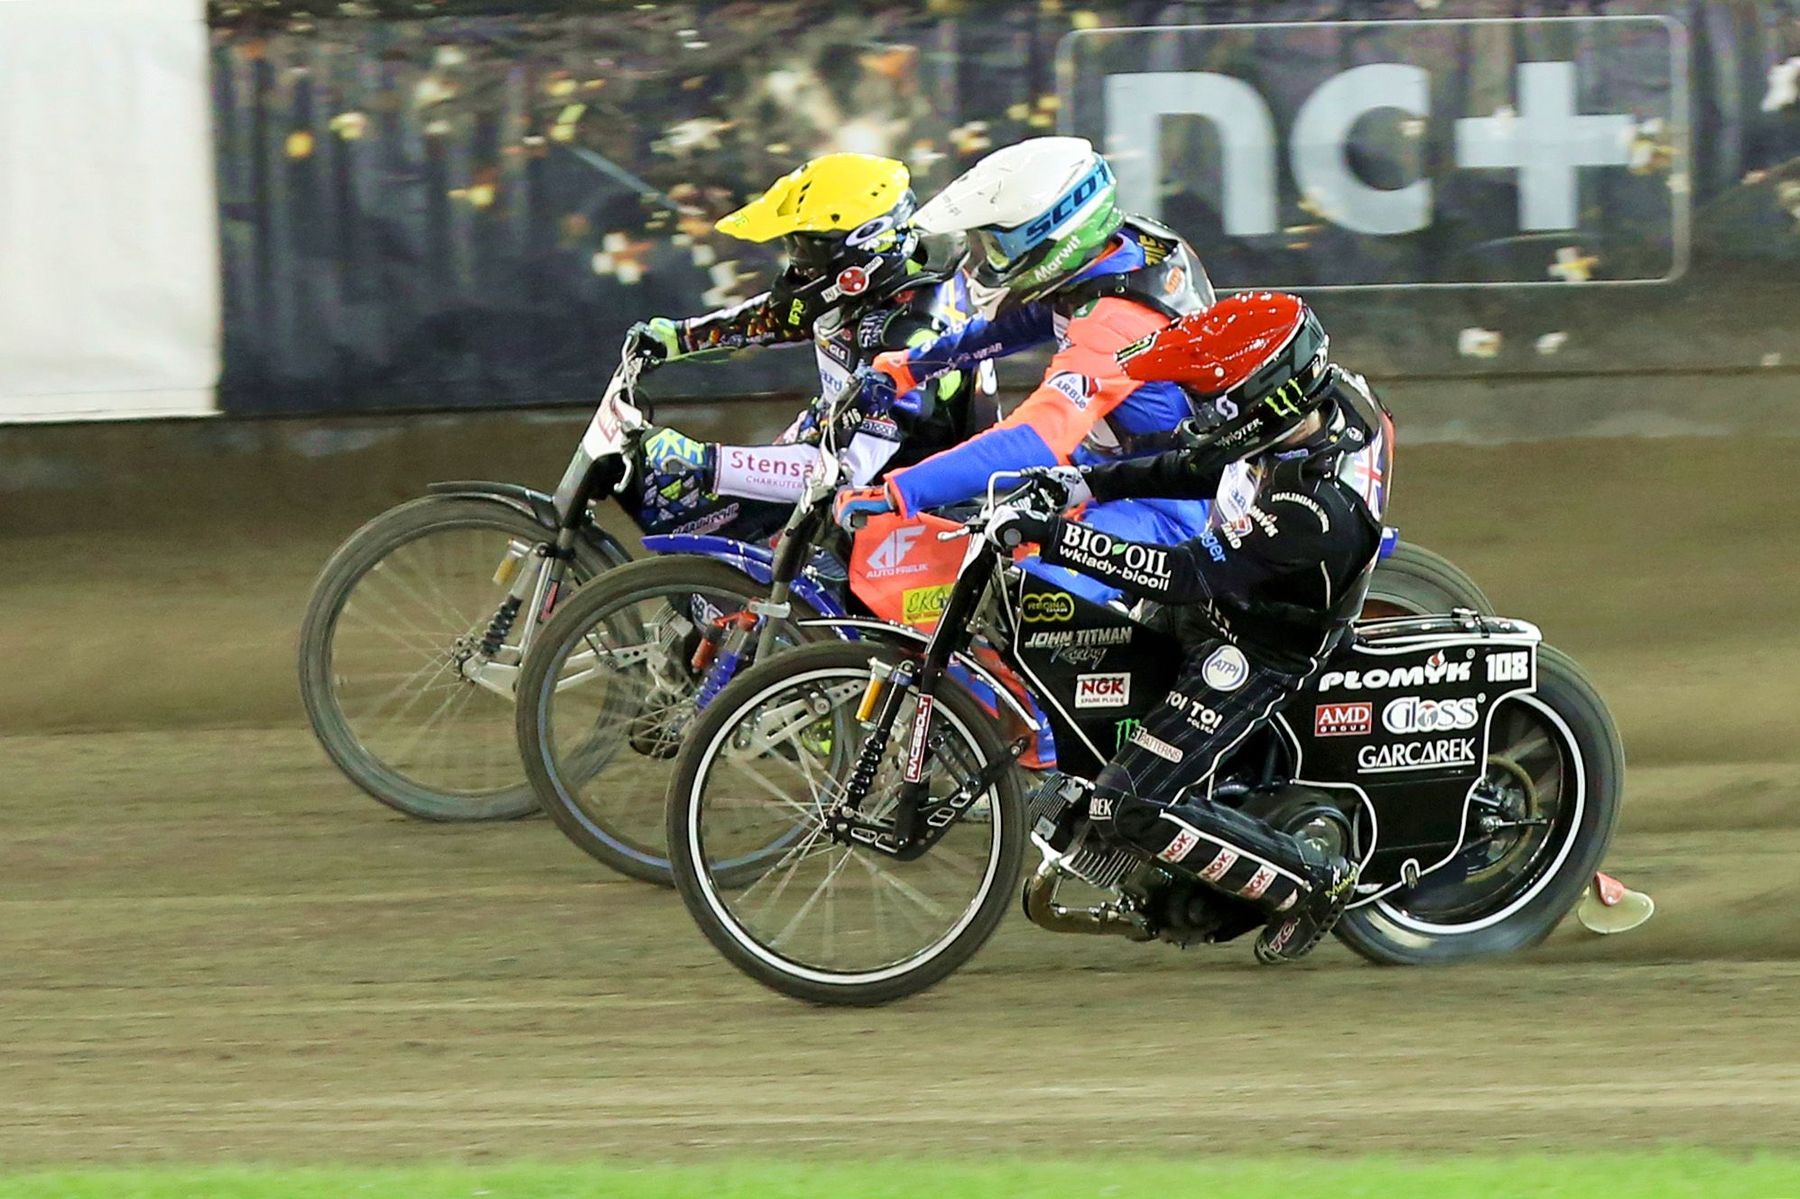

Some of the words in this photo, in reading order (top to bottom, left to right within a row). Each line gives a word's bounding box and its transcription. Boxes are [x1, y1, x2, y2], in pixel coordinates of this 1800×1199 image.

[1104, 60, 1636, 237] nc+
[1033, 234, 1081, 283] Marwit
[829, 344, 846, 360] GLS
[1062, 522, 1112, 557] BIO
[1124, 550, 1173, 580] OIL
[866, 567, 896, 579] AUTO
[1024, 631, 1073, 648] JOHN
[1076, 626, 1132, 646] TITMAN
[1210, 658, 1239, 680] ATPI
[1485, 651, 1529, 683] 108
[1081, 677, 1125, 696] NGK
[1165, 690, 1189, 711] TOI
[1190, 701, 1224, 729] TOI
[1318, 706, 1370, 726] AMD
[906, 697, 931, 779] RACEBOLT
[1320, 724, 1367, 733] GROUP
[1357, 738, 1476, 768] GARCAREK
[1163, 833, 1192, 860] NGK
[1202, 852, 1231, 879] NGK
